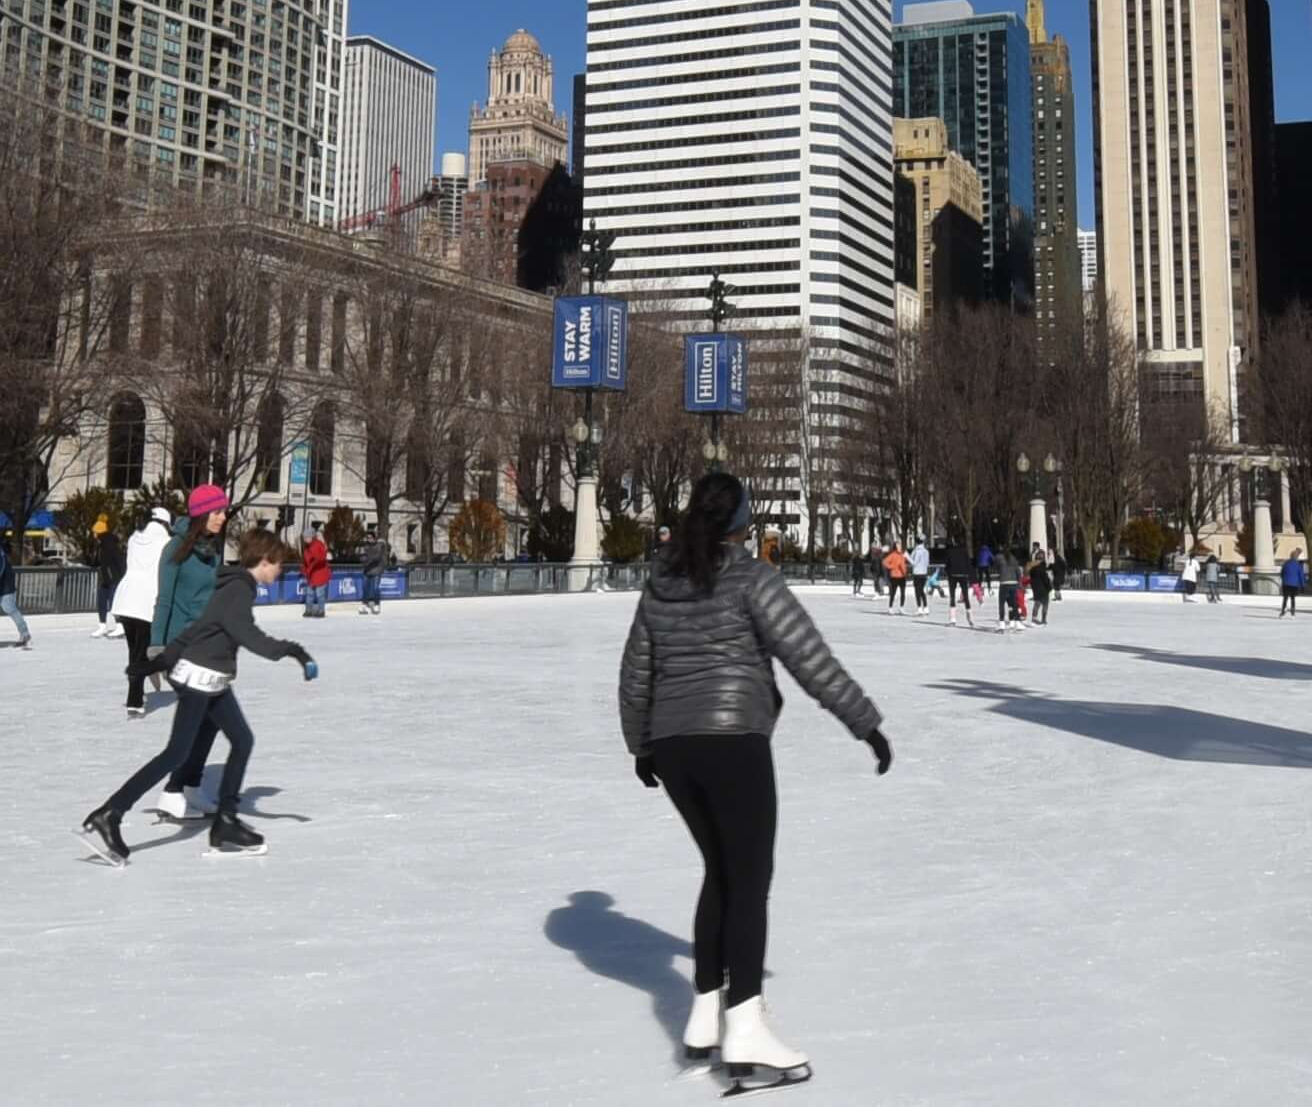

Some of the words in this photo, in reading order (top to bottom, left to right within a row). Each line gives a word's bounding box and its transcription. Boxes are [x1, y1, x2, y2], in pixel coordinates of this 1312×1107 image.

[564, 320, 577, 363] STAY
[579, 306, 592, 362] WARM
[609, 314, 621, 373] Hilton
[698, 347, 713, 397] Hilton
